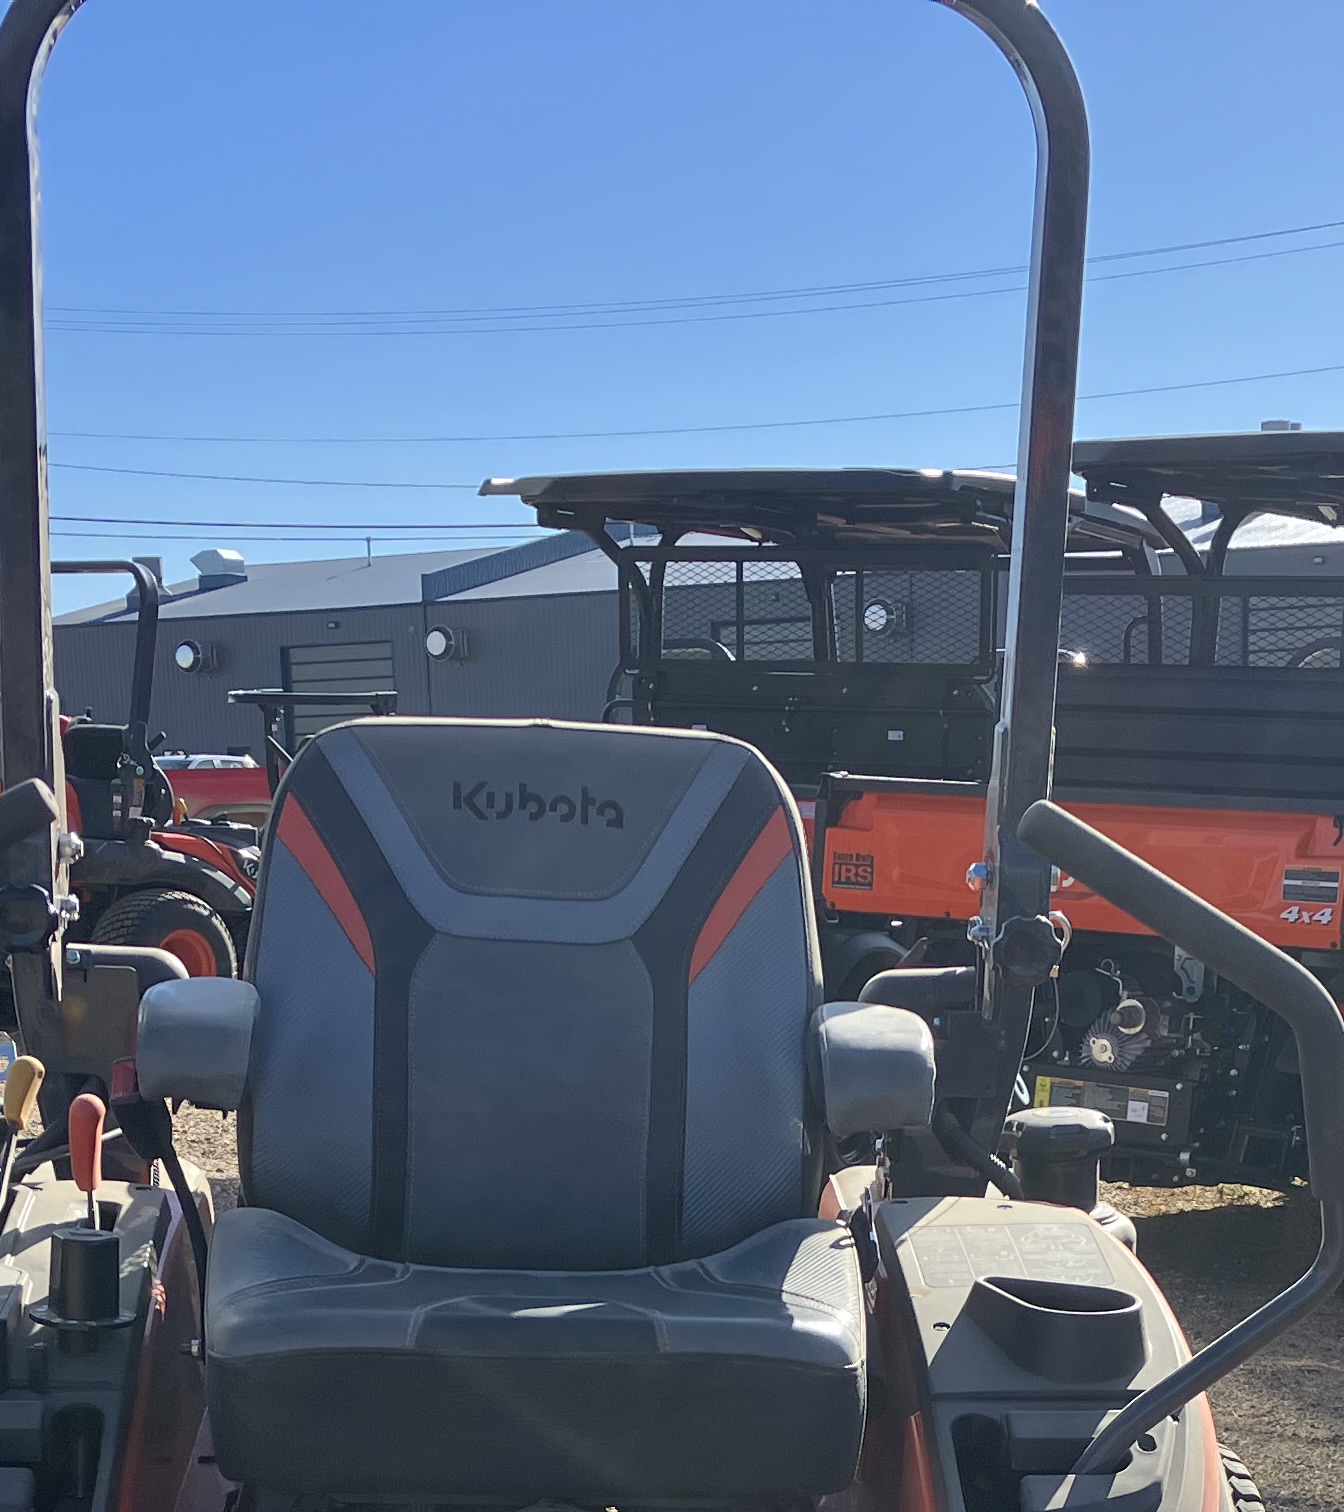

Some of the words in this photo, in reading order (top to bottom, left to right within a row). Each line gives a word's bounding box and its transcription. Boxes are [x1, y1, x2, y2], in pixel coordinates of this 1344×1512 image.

[453, 781, 624, 829] Kubota
[833, 864, 872, 884] IRS
[1280, 906, 1334, 925] 4x4
